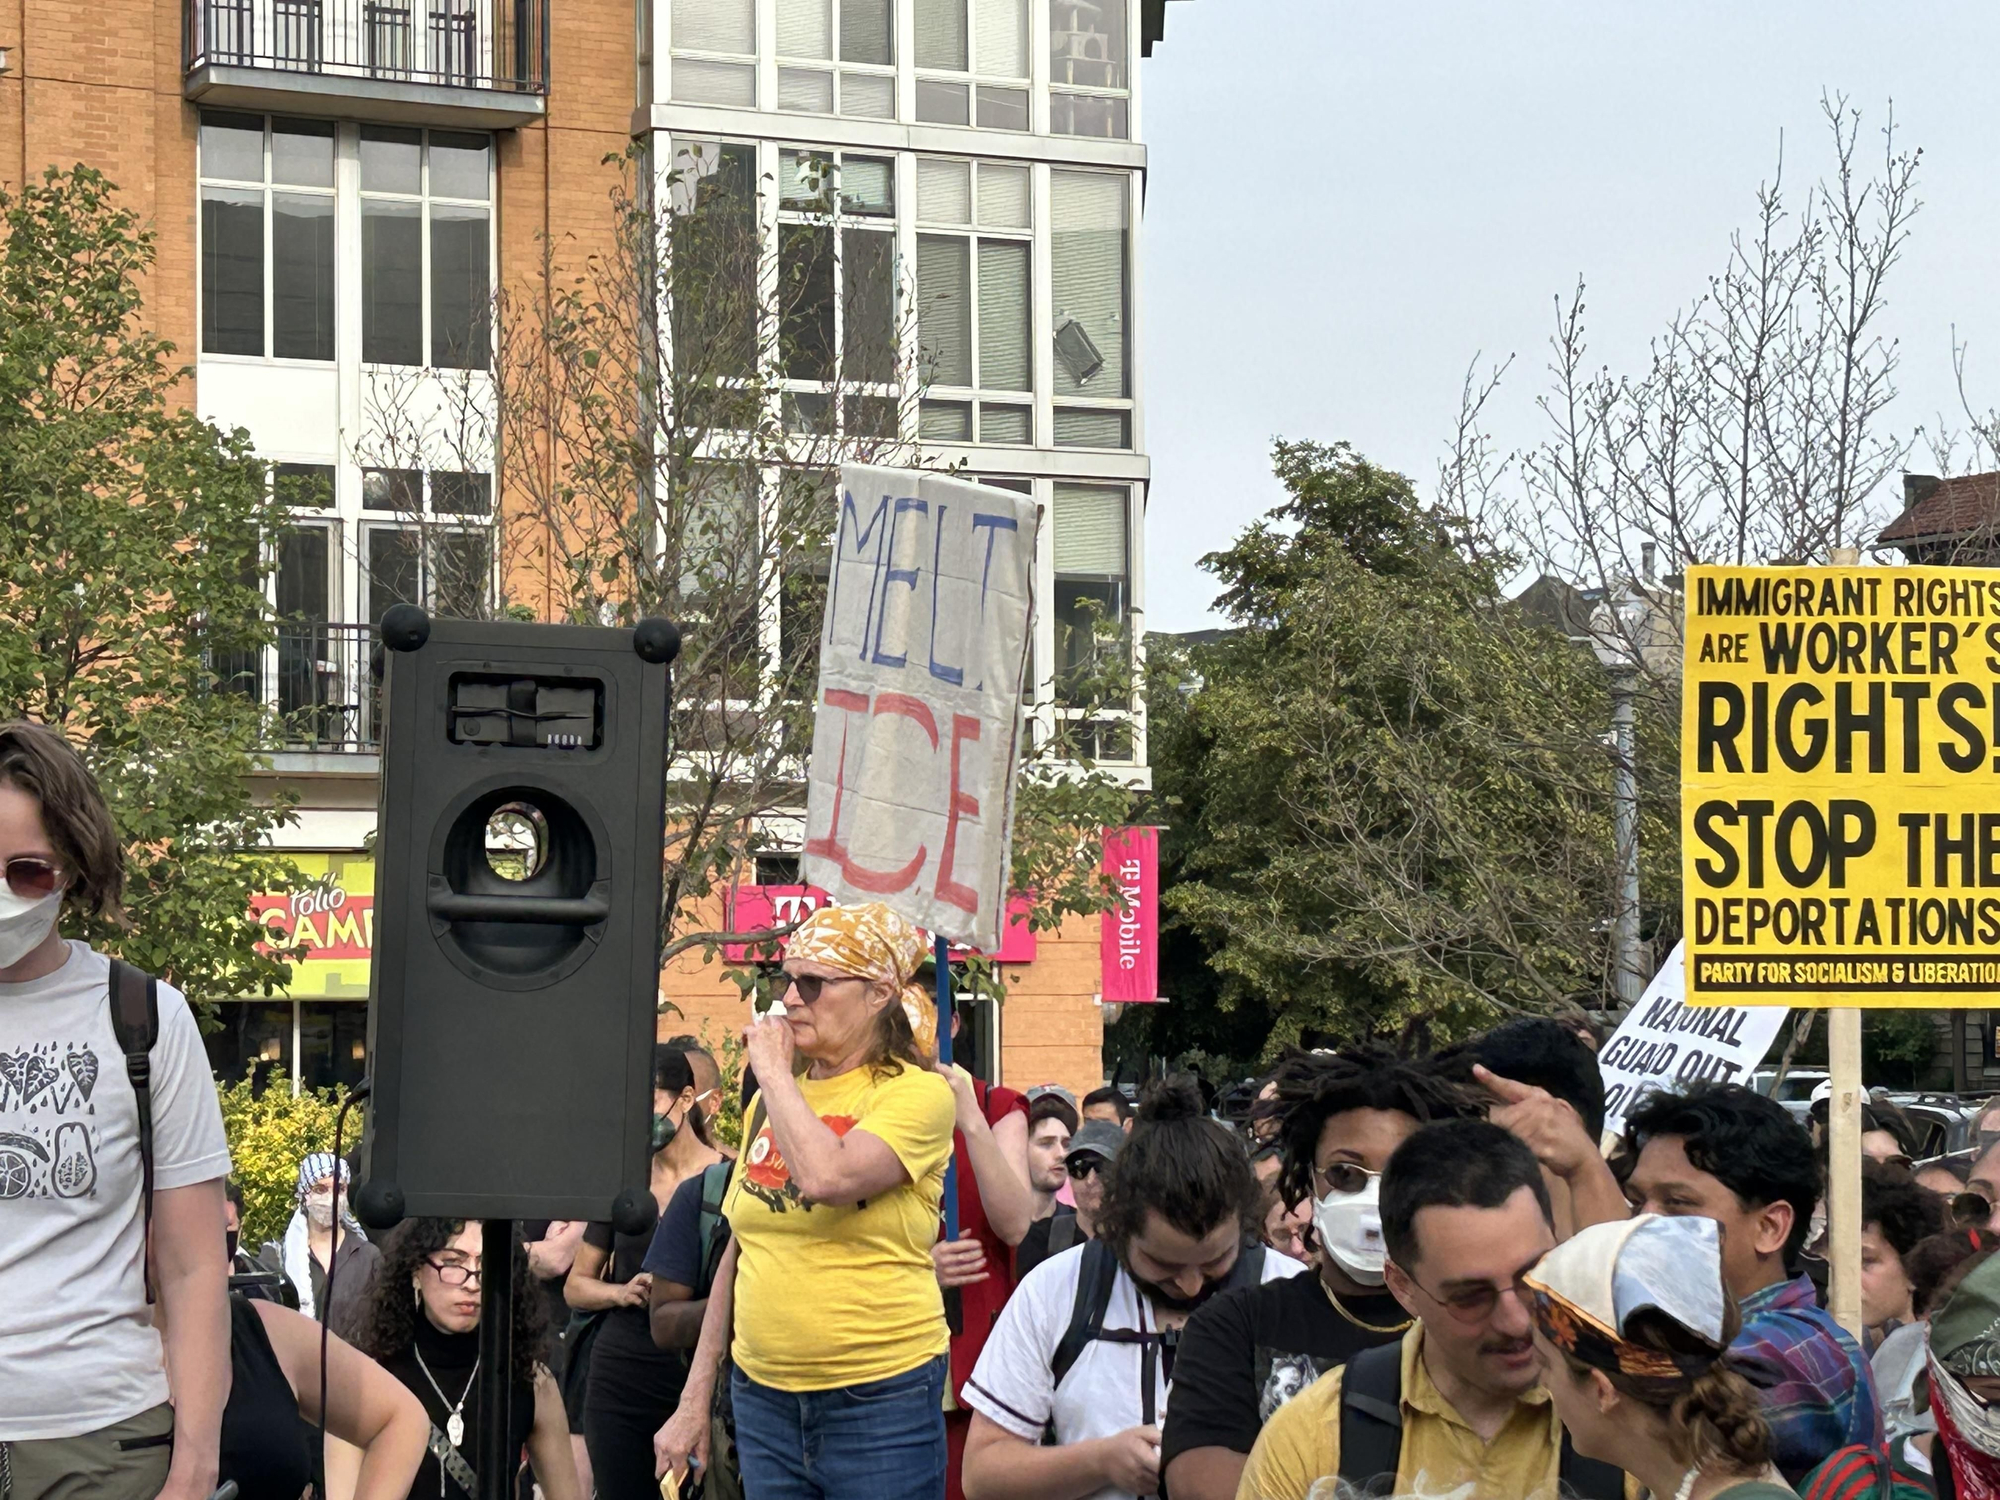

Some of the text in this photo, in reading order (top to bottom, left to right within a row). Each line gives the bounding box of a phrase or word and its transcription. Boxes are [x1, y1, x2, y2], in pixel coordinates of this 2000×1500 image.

[829, 490, 1018, 691] MELT
[1697, 577, 2000, 617] IMMIGRANT RIGHTS
[1699, 633, 1749, 663] ARE
[805, 688, 981, 914] ICE
[1694, 800, 2000, 888] STOP THE
[1694, 897, 2000, 946] DEPORTATIONS
[1700, 962, 2000, 984] PARTY FOR SOCIALISM & LIBERATIO
[1600, 1036, 1743, 1085] GUAD OUT
